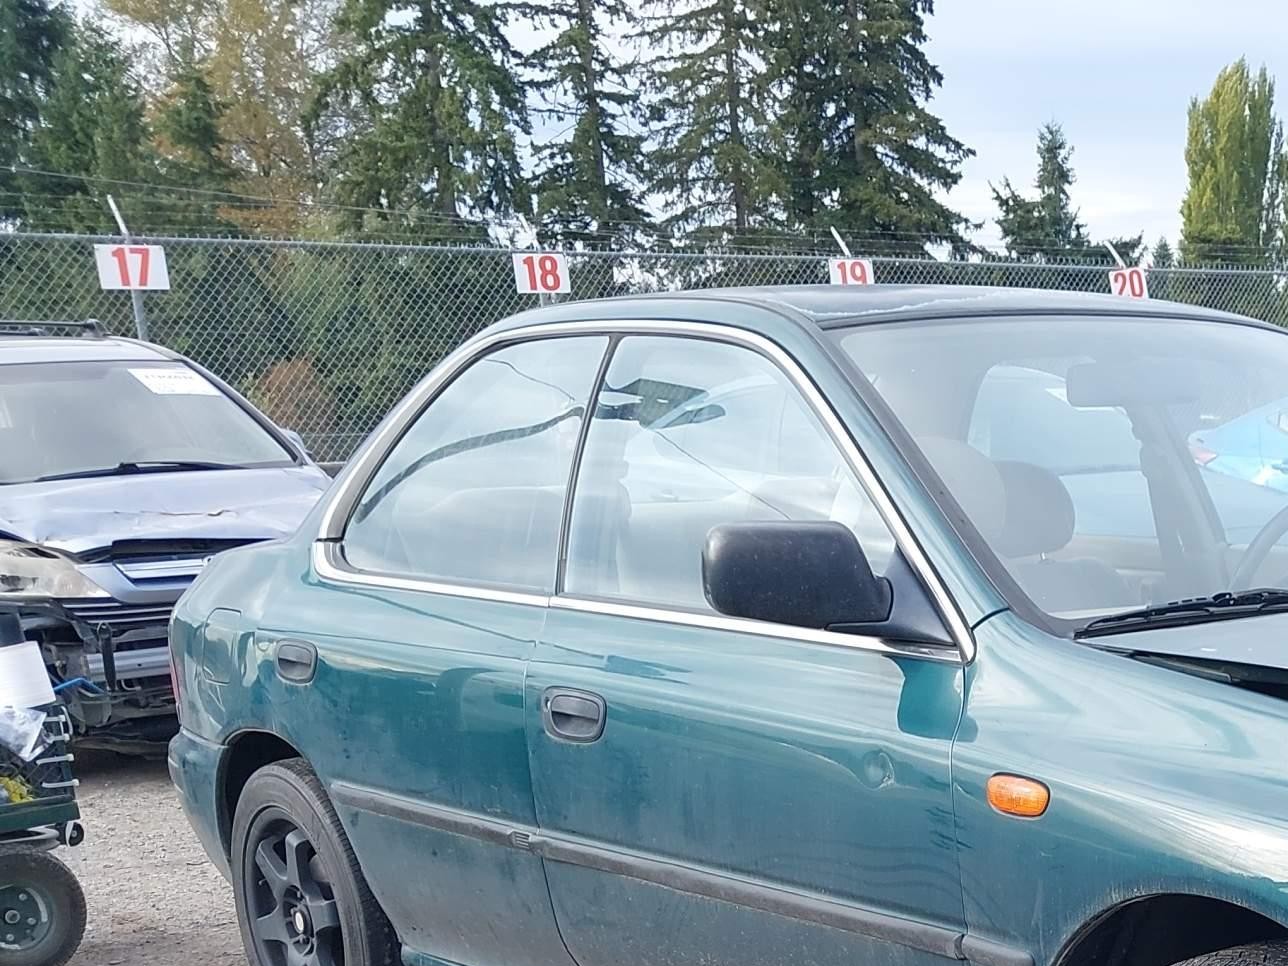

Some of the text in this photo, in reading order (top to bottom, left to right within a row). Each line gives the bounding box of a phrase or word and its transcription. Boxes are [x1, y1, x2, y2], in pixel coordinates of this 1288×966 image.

[111, 247, 149, 287] 17
[522, 255, 561, 291] 18
[837, 261, 868, 285] 19
[1114, 270, 1144, 297] 20
